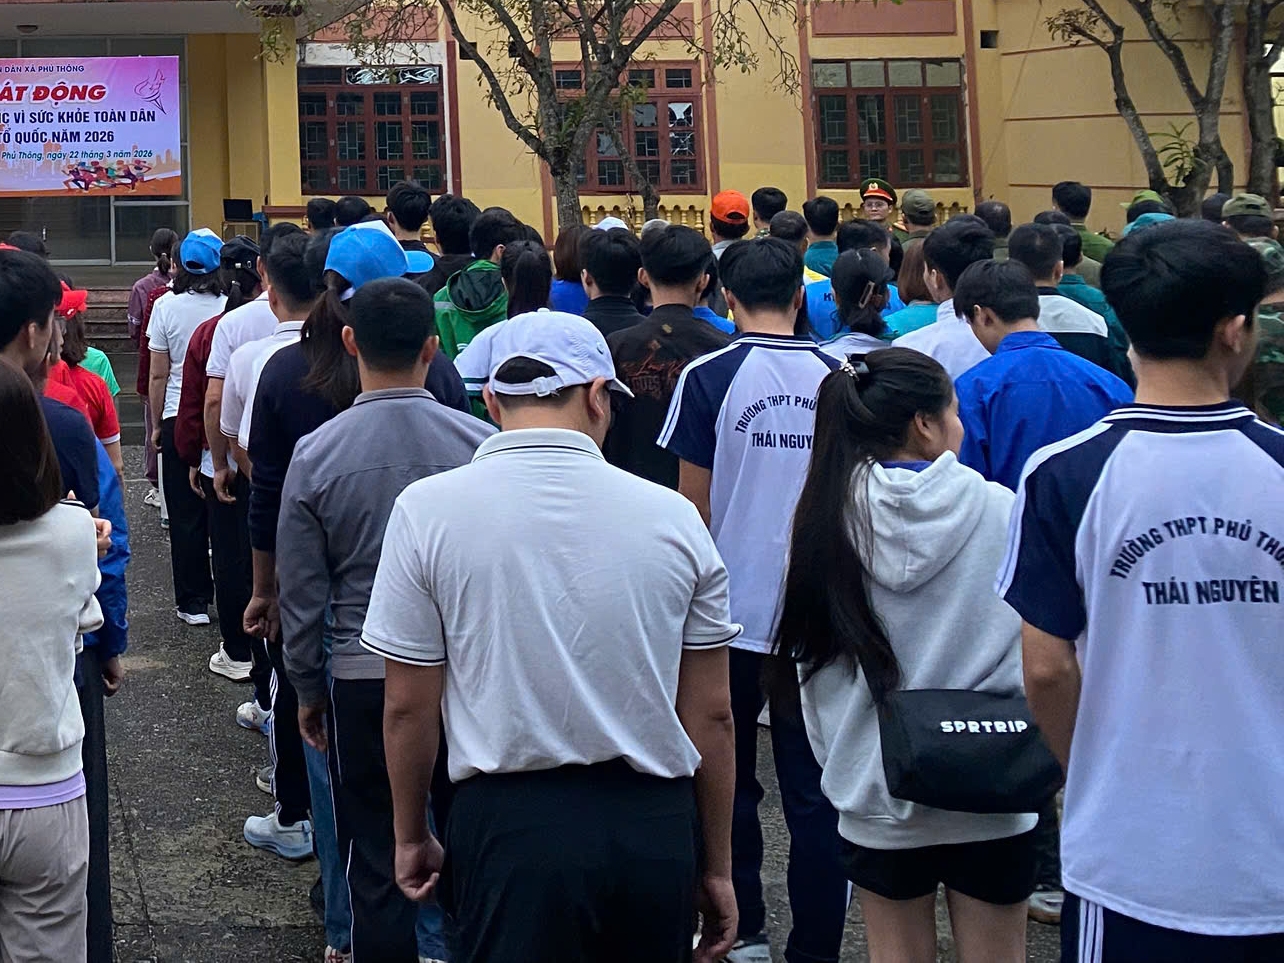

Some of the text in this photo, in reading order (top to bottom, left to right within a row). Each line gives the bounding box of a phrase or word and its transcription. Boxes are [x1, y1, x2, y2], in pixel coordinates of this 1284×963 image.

[4, 64, 21, 73] DÂN
[56, 63, 85, 72] THÔNG
[32, 81, 107, 106] ĐỘNG
[13, 109, 25, 124] VÌ
[29, 109, 54, 124] SỨC
[58, 108, 90, 123] KHỎE
[94, 108, 126, 123] TOÀN
[130, 108, 156, 122] DÂN
[14, 127, 48, 144] QUỐC
[51, 129, 81, 143] NĂM
[84, 131, 115, 143] 2026
[46, 149, 67, 161] ngày
[69, 150, 79, 158] 22
[81, 149, 104, 160] tháng
[106, 150, 112, 158] 3
[113, 149, 131, 158] năm
[133, 149, 153, 157] 2026
[735, 399, 767, 434] TRƯỜNG
[767, 395, 791, 407] THPT
[752, 430, 813, 449] THÁI NGUY
[1110, 528, 1165, 579] TRƯỜNG
[1162, 516, 1208, 538] THPT
[1213, 517, 1252, 542] PHỦ
[1141, 575, 1279, 605] THÁI NGUYÊN
[940, 720, 1028, 733] SPRTRIP
